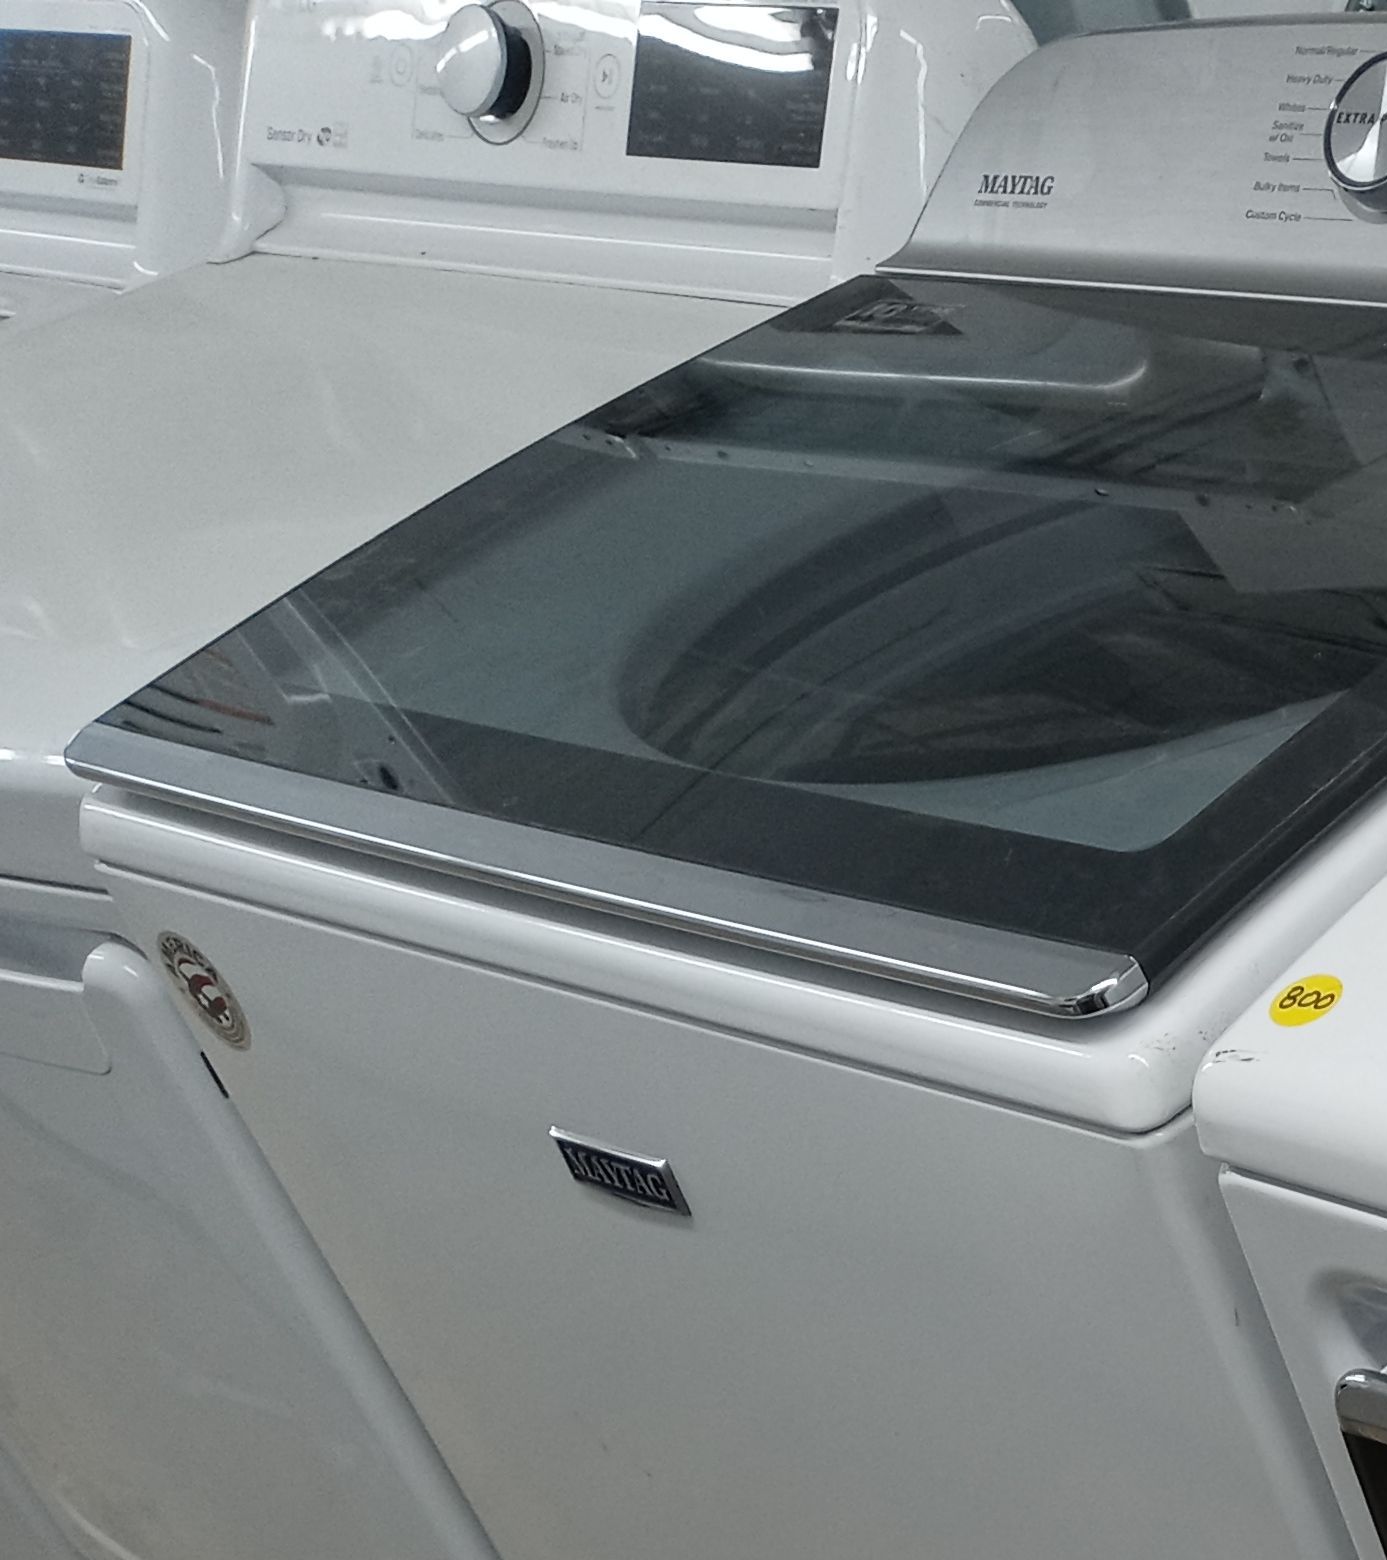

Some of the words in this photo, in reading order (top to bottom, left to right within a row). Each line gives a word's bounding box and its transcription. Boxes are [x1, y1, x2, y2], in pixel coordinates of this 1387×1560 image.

[1336, 112, 1375, 124] EXTRA
[978, 174, 1055, 195] MAYTAG
[1279, 985, 1335, 1010] 800
[563, 1147, 671, 1201] MAYTAG
